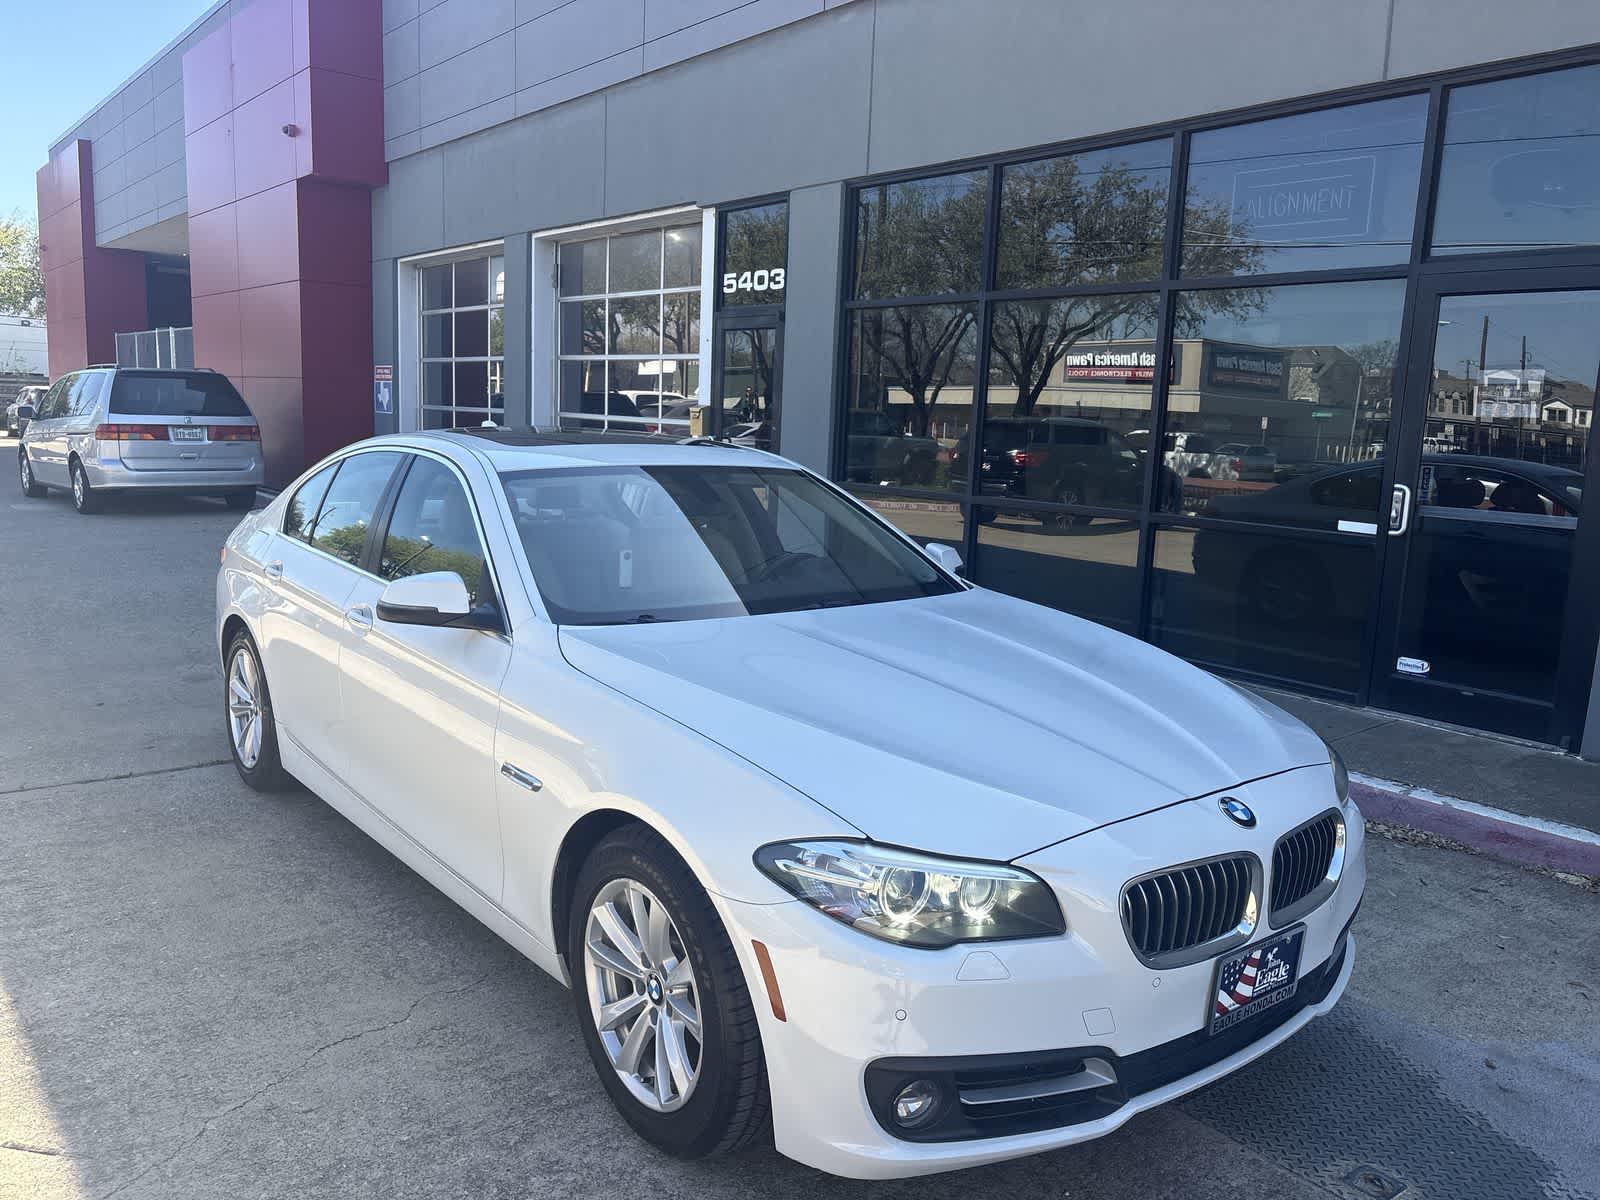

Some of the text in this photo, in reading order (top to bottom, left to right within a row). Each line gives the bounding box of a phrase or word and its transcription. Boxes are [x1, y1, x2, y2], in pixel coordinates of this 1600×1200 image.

[1247, 185, 1357, 218] ALIGNMENT
[723, 268, 785, 293] 5403
[1255, 961, 1290, 988] Eagle
